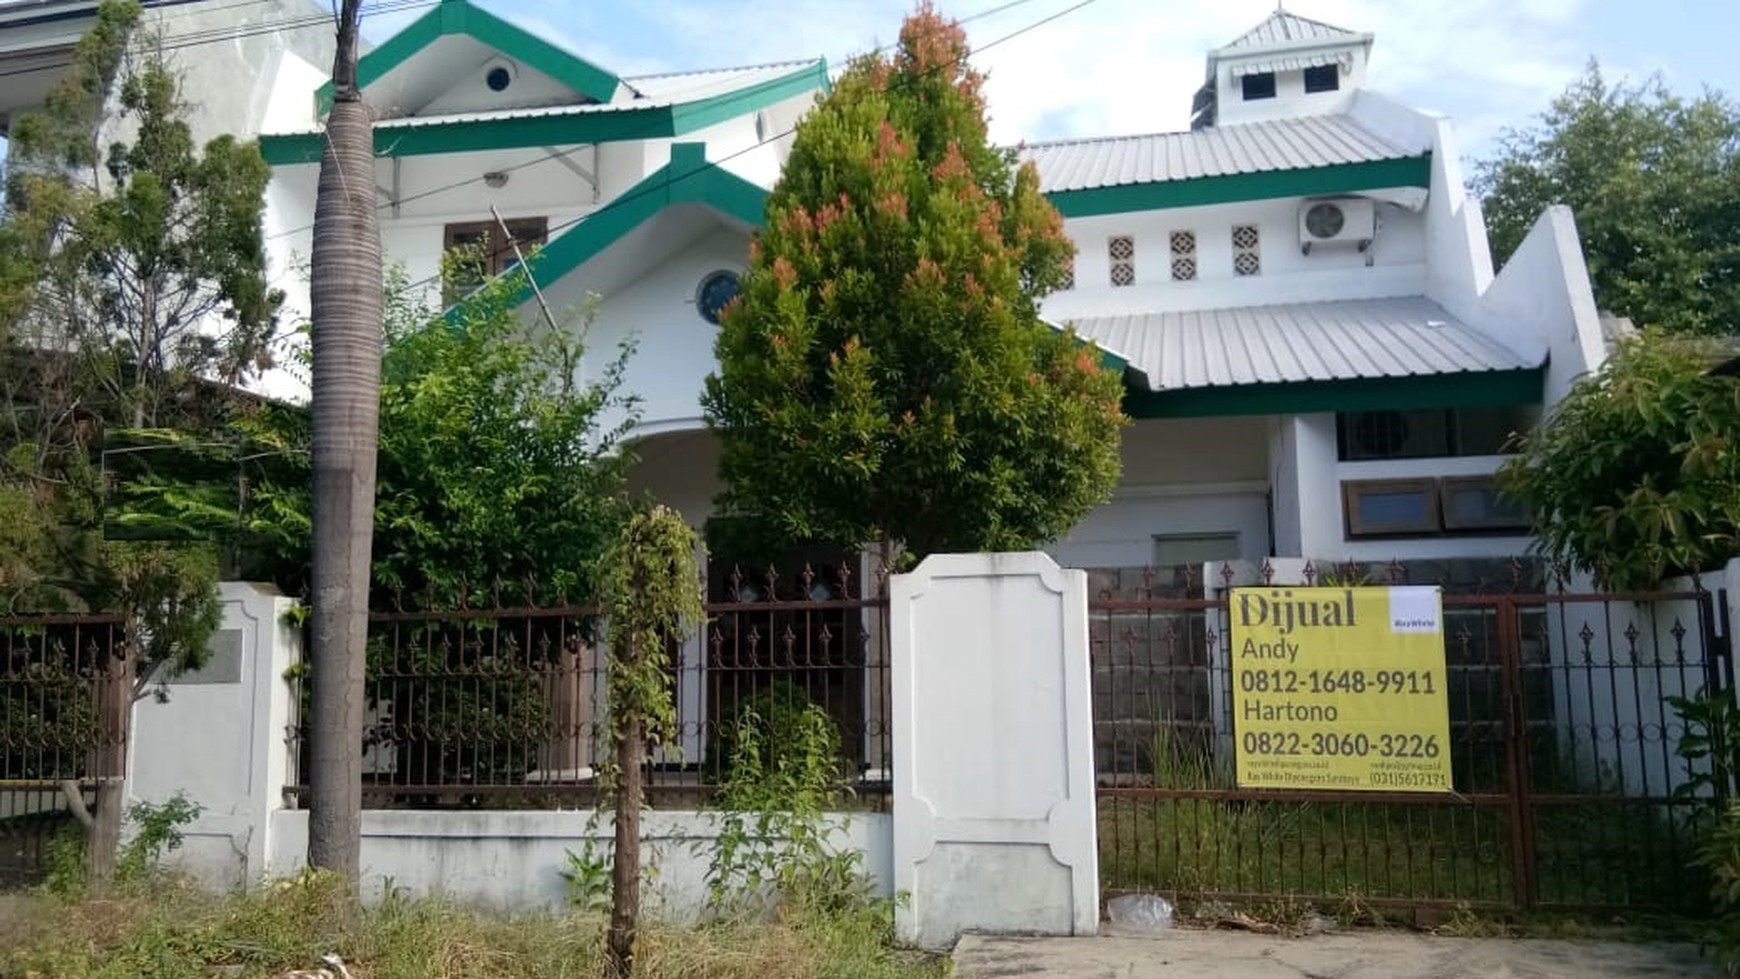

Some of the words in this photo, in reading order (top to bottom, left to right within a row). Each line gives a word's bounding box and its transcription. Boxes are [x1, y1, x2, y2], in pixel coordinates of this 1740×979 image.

[1239, 589, 1356, 634] Dijual
[1241, 638, 1299, 663] Andy
[1241, 670, 1436, 694] 0812-1648-9911
[1244, 699, 1338, 721] Hartono
[1243, 732, 1440, 758] 0822-3060-3226
